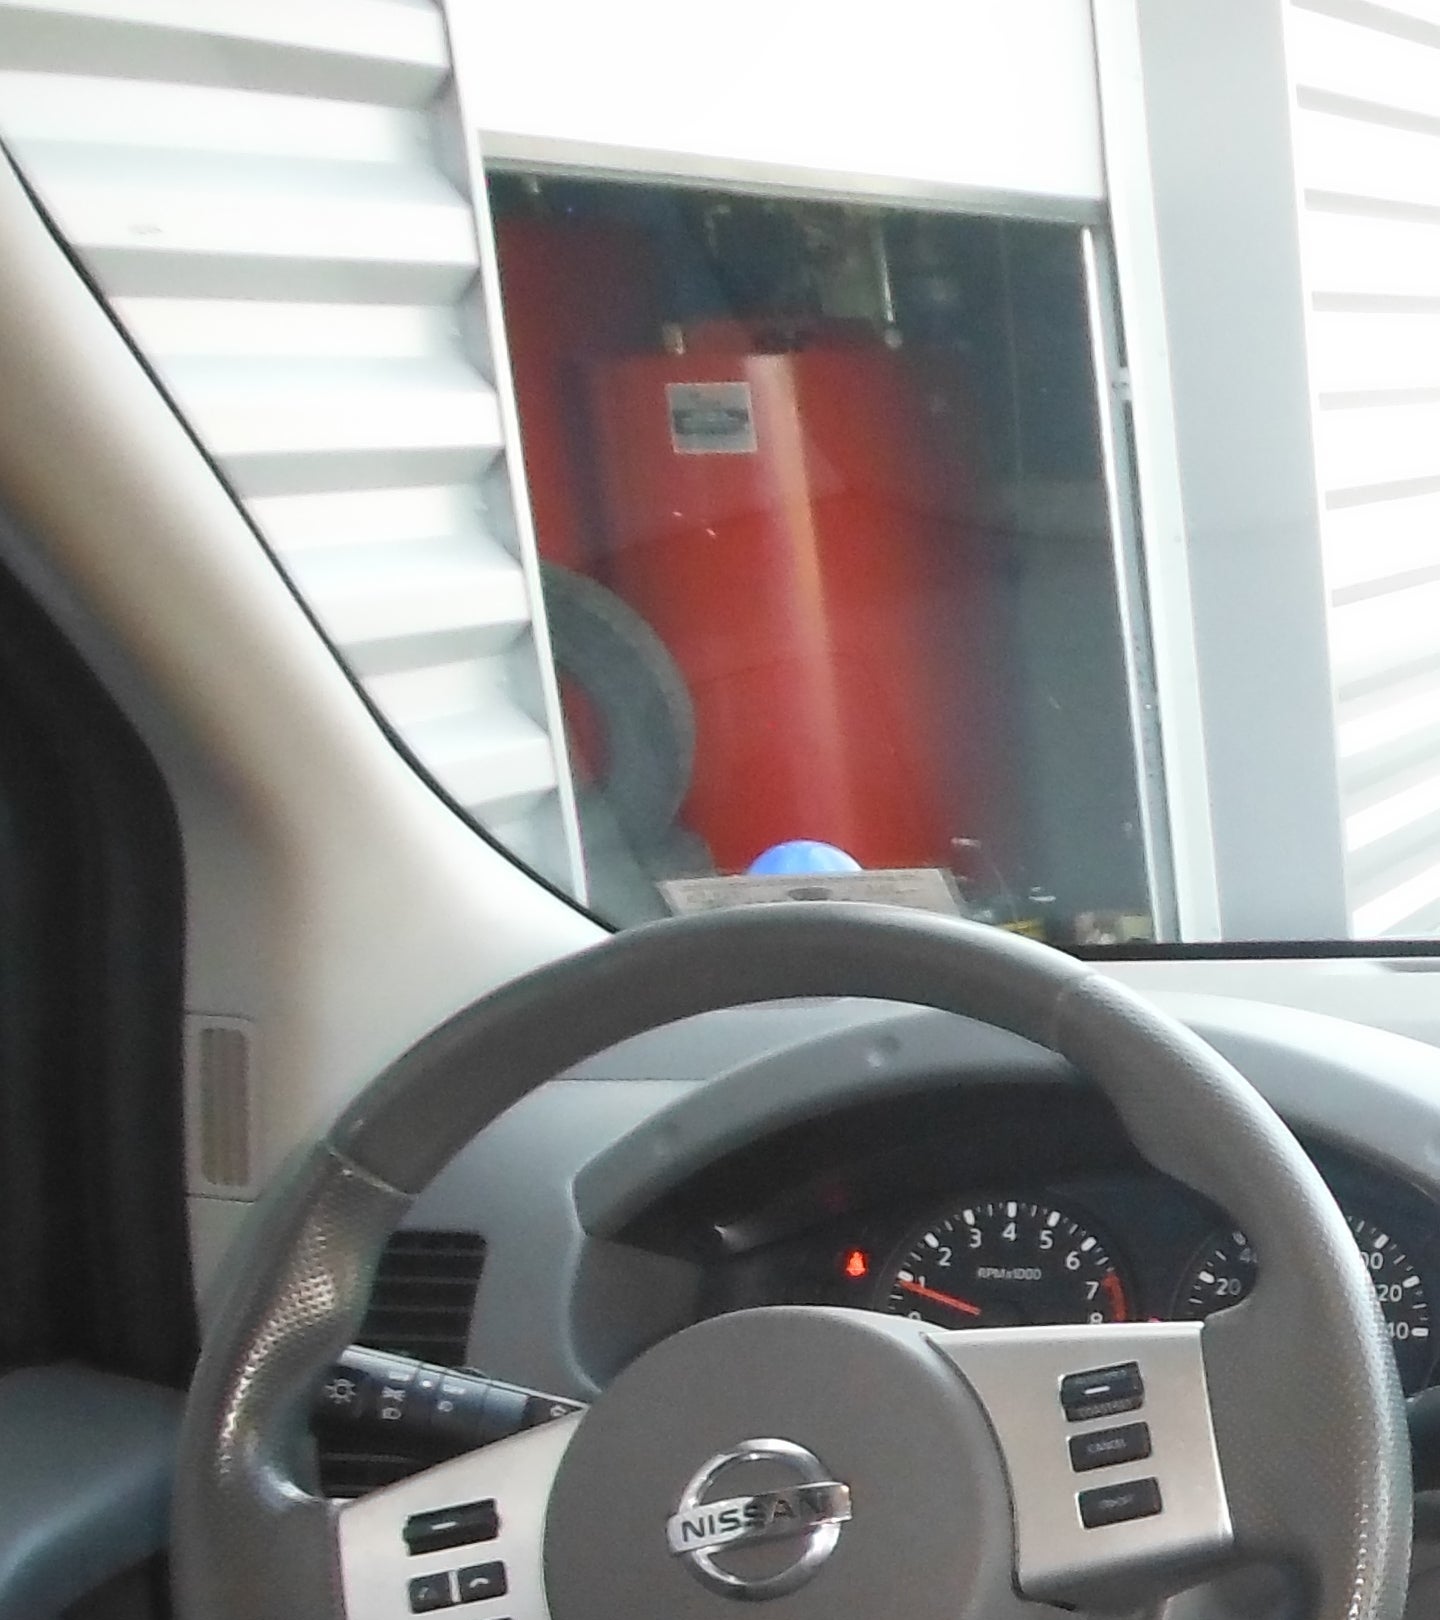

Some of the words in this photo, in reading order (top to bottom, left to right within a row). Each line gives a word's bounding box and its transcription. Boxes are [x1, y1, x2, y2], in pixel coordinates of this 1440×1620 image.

[968, 1228, 982, 1249] 3
[1002, 1221, 1018, 1242] 4
[1039, 1230, 1054, 1250] 5
[938, 1247, 952, 1267] 2
[1065, 1252, 1081, 1271] 6
[1085, 1280, 1099, 1301] 7
[1216, 1277, 1242, 1296] 20
[1376, 1283, 1402, 1303] 20
